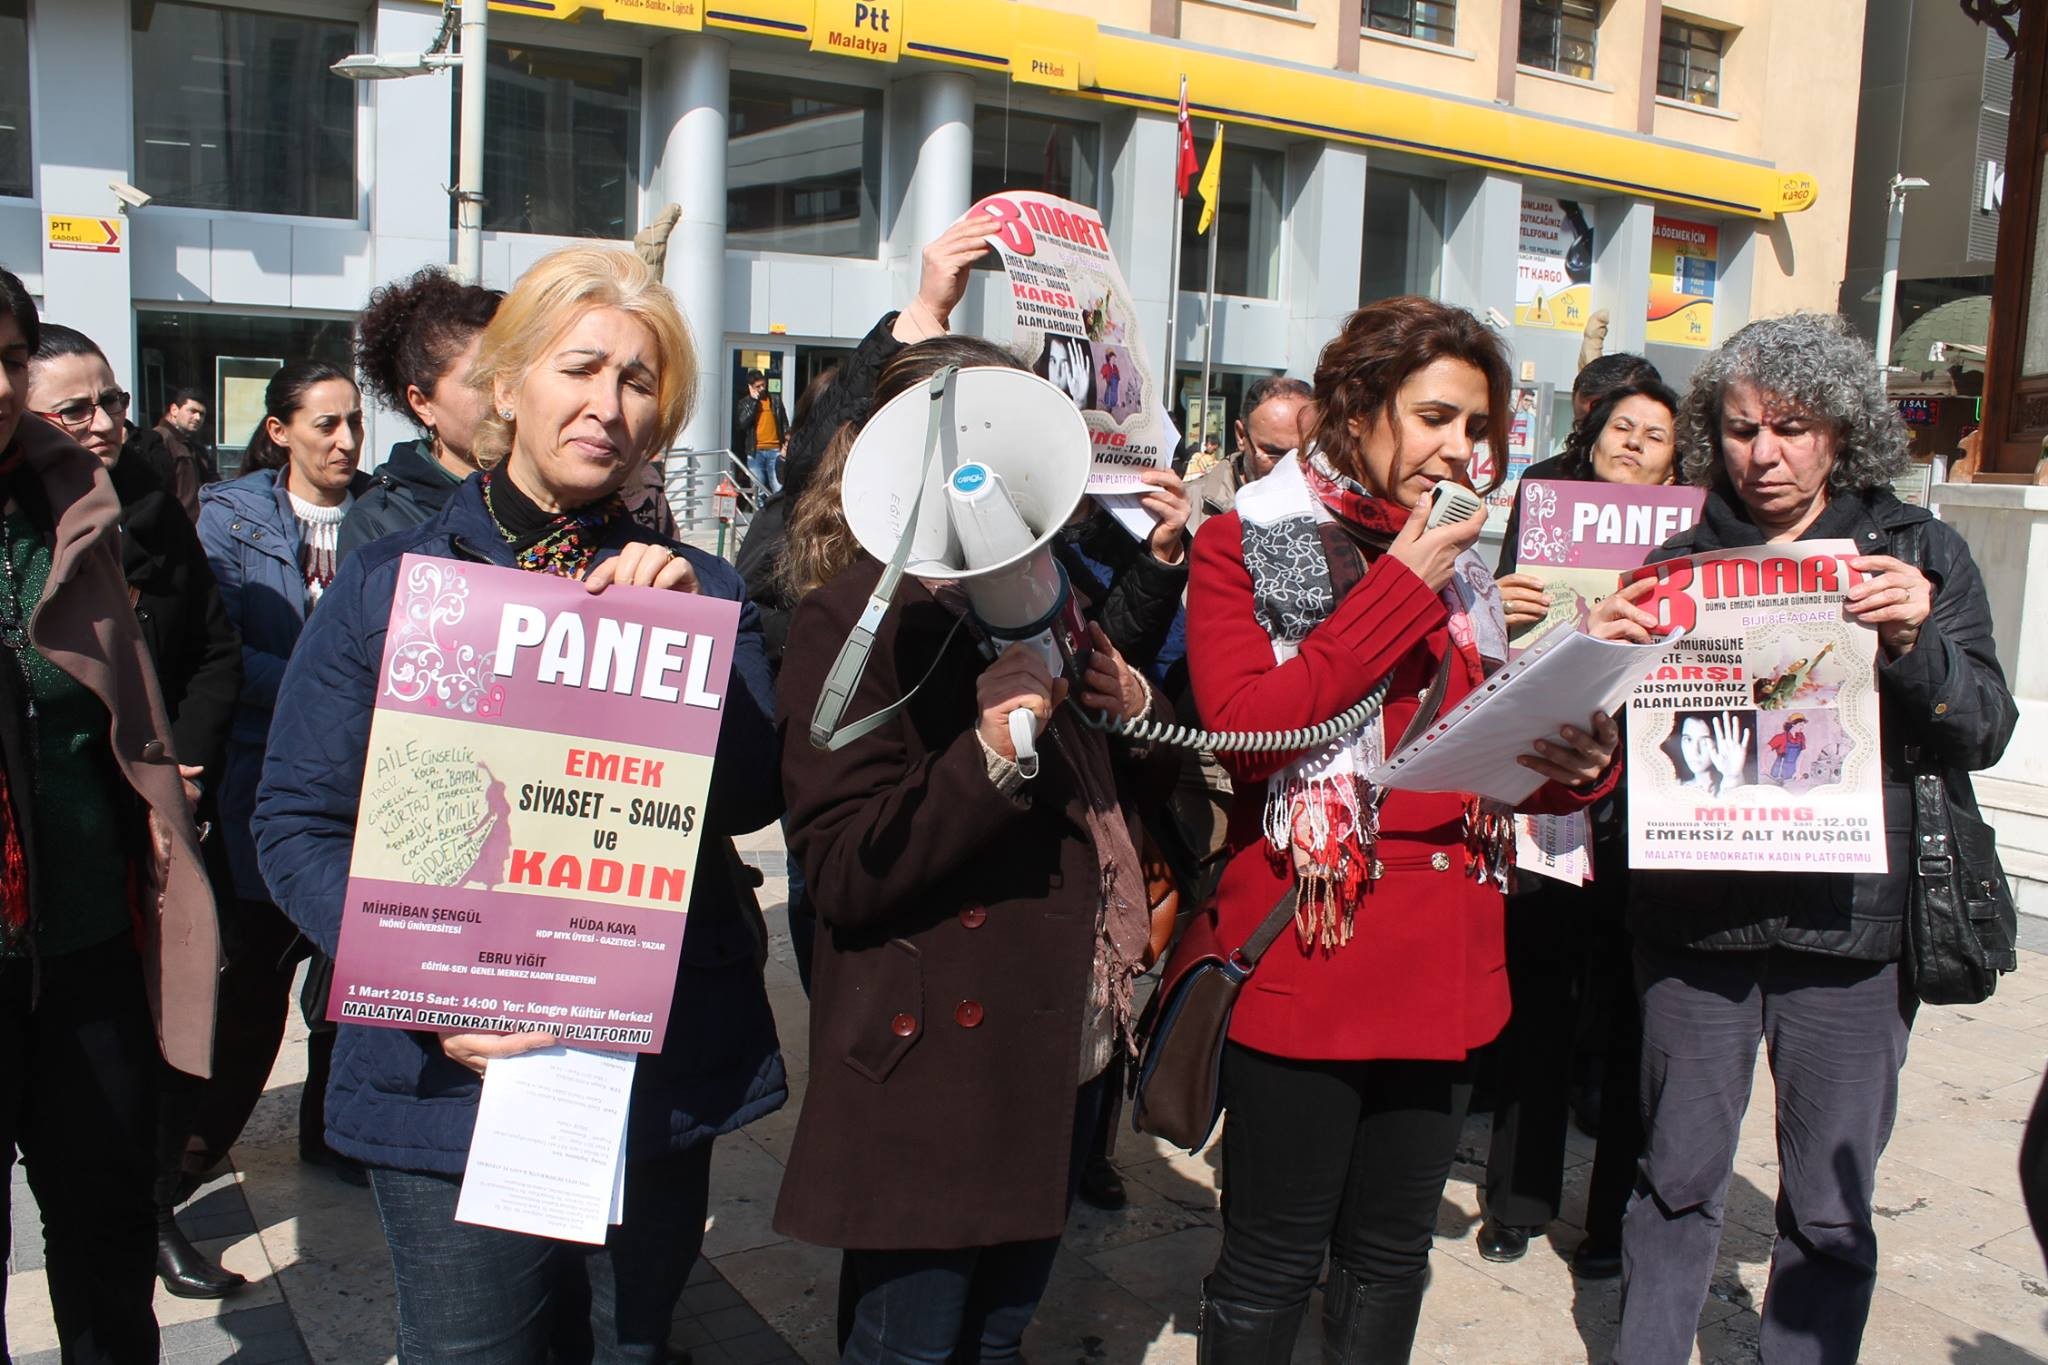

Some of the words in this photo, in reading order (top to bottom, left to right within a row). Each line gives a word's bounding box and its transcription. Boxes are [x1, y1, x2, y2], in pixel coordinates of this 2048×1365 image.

[855, 3, 890, 32] Ptt
[828, 31, 888, 54] Malatya
[52, 222, 72, 231] PTT
[1020, 201, 1108, 252] MART
[1531, 268, 1562, 283] KARGO
[1013, 283, 1075, 309] KARŞI
[1016, 301, 1080, 321] SUSMUYORUZ
[1017, 314, 1084, 336] ALANLARDAYIZ
[493, 603, 721, 711] PANEL
[1697, 654, 1743, 665] SAVAŞA
[1645, 666, 1743, 682] ARŞI
[1633, 683, 1747, 694] SUSMUYORUZ
[1633, 696, 1749, 709] ALANLARDAYIZ
[565, 748, 665, 788] EMEK
[519, 779, 605, 819] SİYASET
[629, 797, 696, 837] SAVAŞ
[593, 829, 618, 851] ve
[1645, 828, 1735, 840] EMEKSİZ
[1742, 830, 1774, 841] ALT
[1782, 829, 1871, 844] KAVŞAĞI
[1644, 850, 1693, 860] MALATYA
[1768, 852, 1801, 861] KADIN
[1805, 852, 1872, 863] PLATFORMU
[508, 849, 687, 902] KADIN
[362, 899, 430, 919] MİHRİBAN
[431, 907, 482, 924] ŞENGÜL
[379, 917, 406, 929] İNÖNÜ
[407, 921, 463, 935] ÜNİVERSİTESİ
[569, 916, 604, 932] HÜDA
[606, 922, 637, 936] KAYA
[536, 929, 553, 938] HDP
[553, 930, 571, 940] MYK
[600, 936, 636, 947] GAZETECİ
[641, 940, 666, 951] YAZAR
[478, 951, 512, 965] EBRU
[515, 952, 547, 967] YİĞİT
[470, 966, 496, 976] GENEL
[497, 968, 530, 979] MERKEZ
[530, 971, 554, 980] KADIN
[555, 973, 597, 985] SEKRETERİ
[348, 984, 356, 996] 1
[359, 986, 390, 999] Mart
[391, 987, 425, 1003] 2015
[426, 992, 459, 1007] Saat:
[462, 997, 498, 1010] 14:00
[502, 999, 525, 1013] Yer:
[527, 1002, 568, 1018] Kongre
[570, 1004, 606, 1020] Kültür
[607, 1008, 654, 1023] Merkezi
[342, 1001, 413, 1022] MALATYA
[416, 1009, 516, 1032] DEMOKRATİK
[517, 1019, 562, 1038] KADIN
[564, 1023, 653, 1045] PLATFORMU
